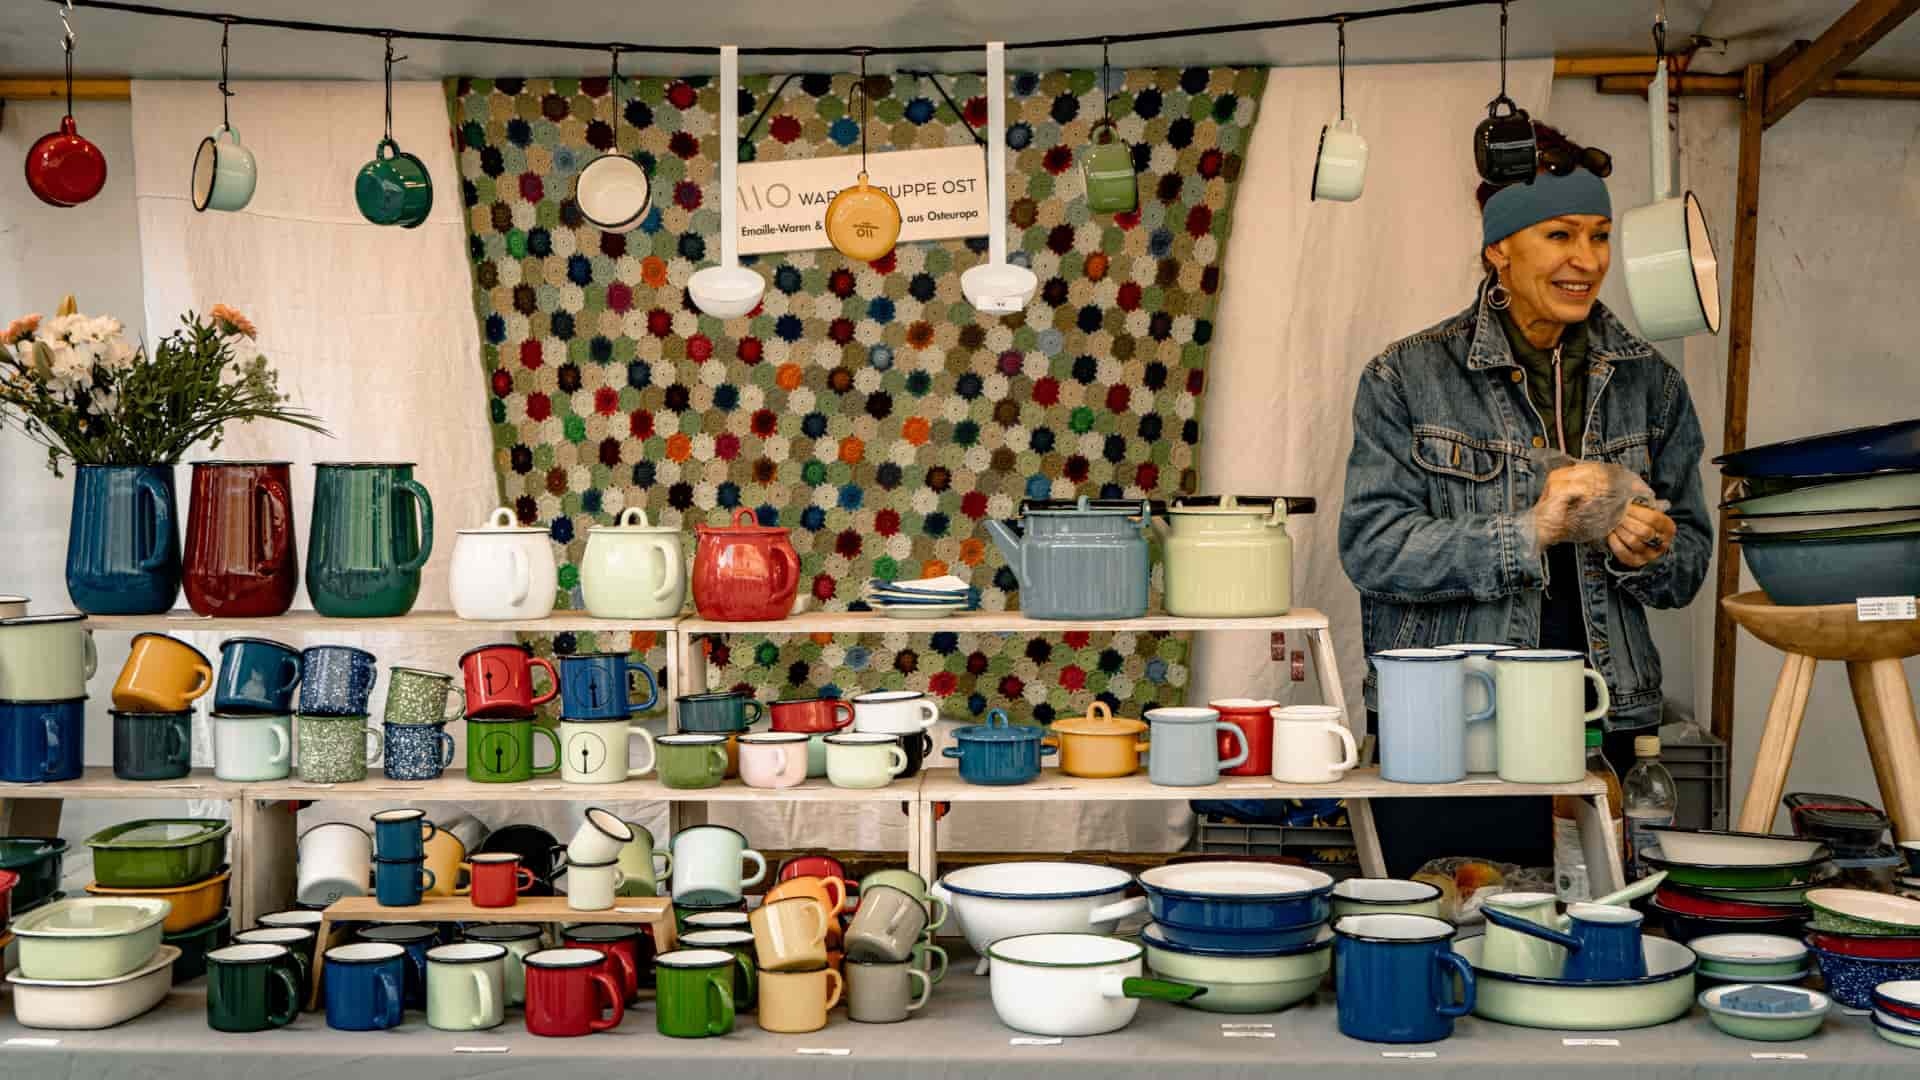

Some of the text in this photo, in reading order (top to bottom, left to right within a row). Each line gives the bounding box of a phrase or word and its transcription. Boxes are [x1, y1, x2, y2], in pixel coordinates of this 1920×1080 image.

[942, 179, 977, 194] OST
[741, 223, 811, 236] Emaille-Waren
[815, 220, 823, 230] &
[907, 214, 924, 223] aus
[927, 210, 979, 221] Osteuropa
